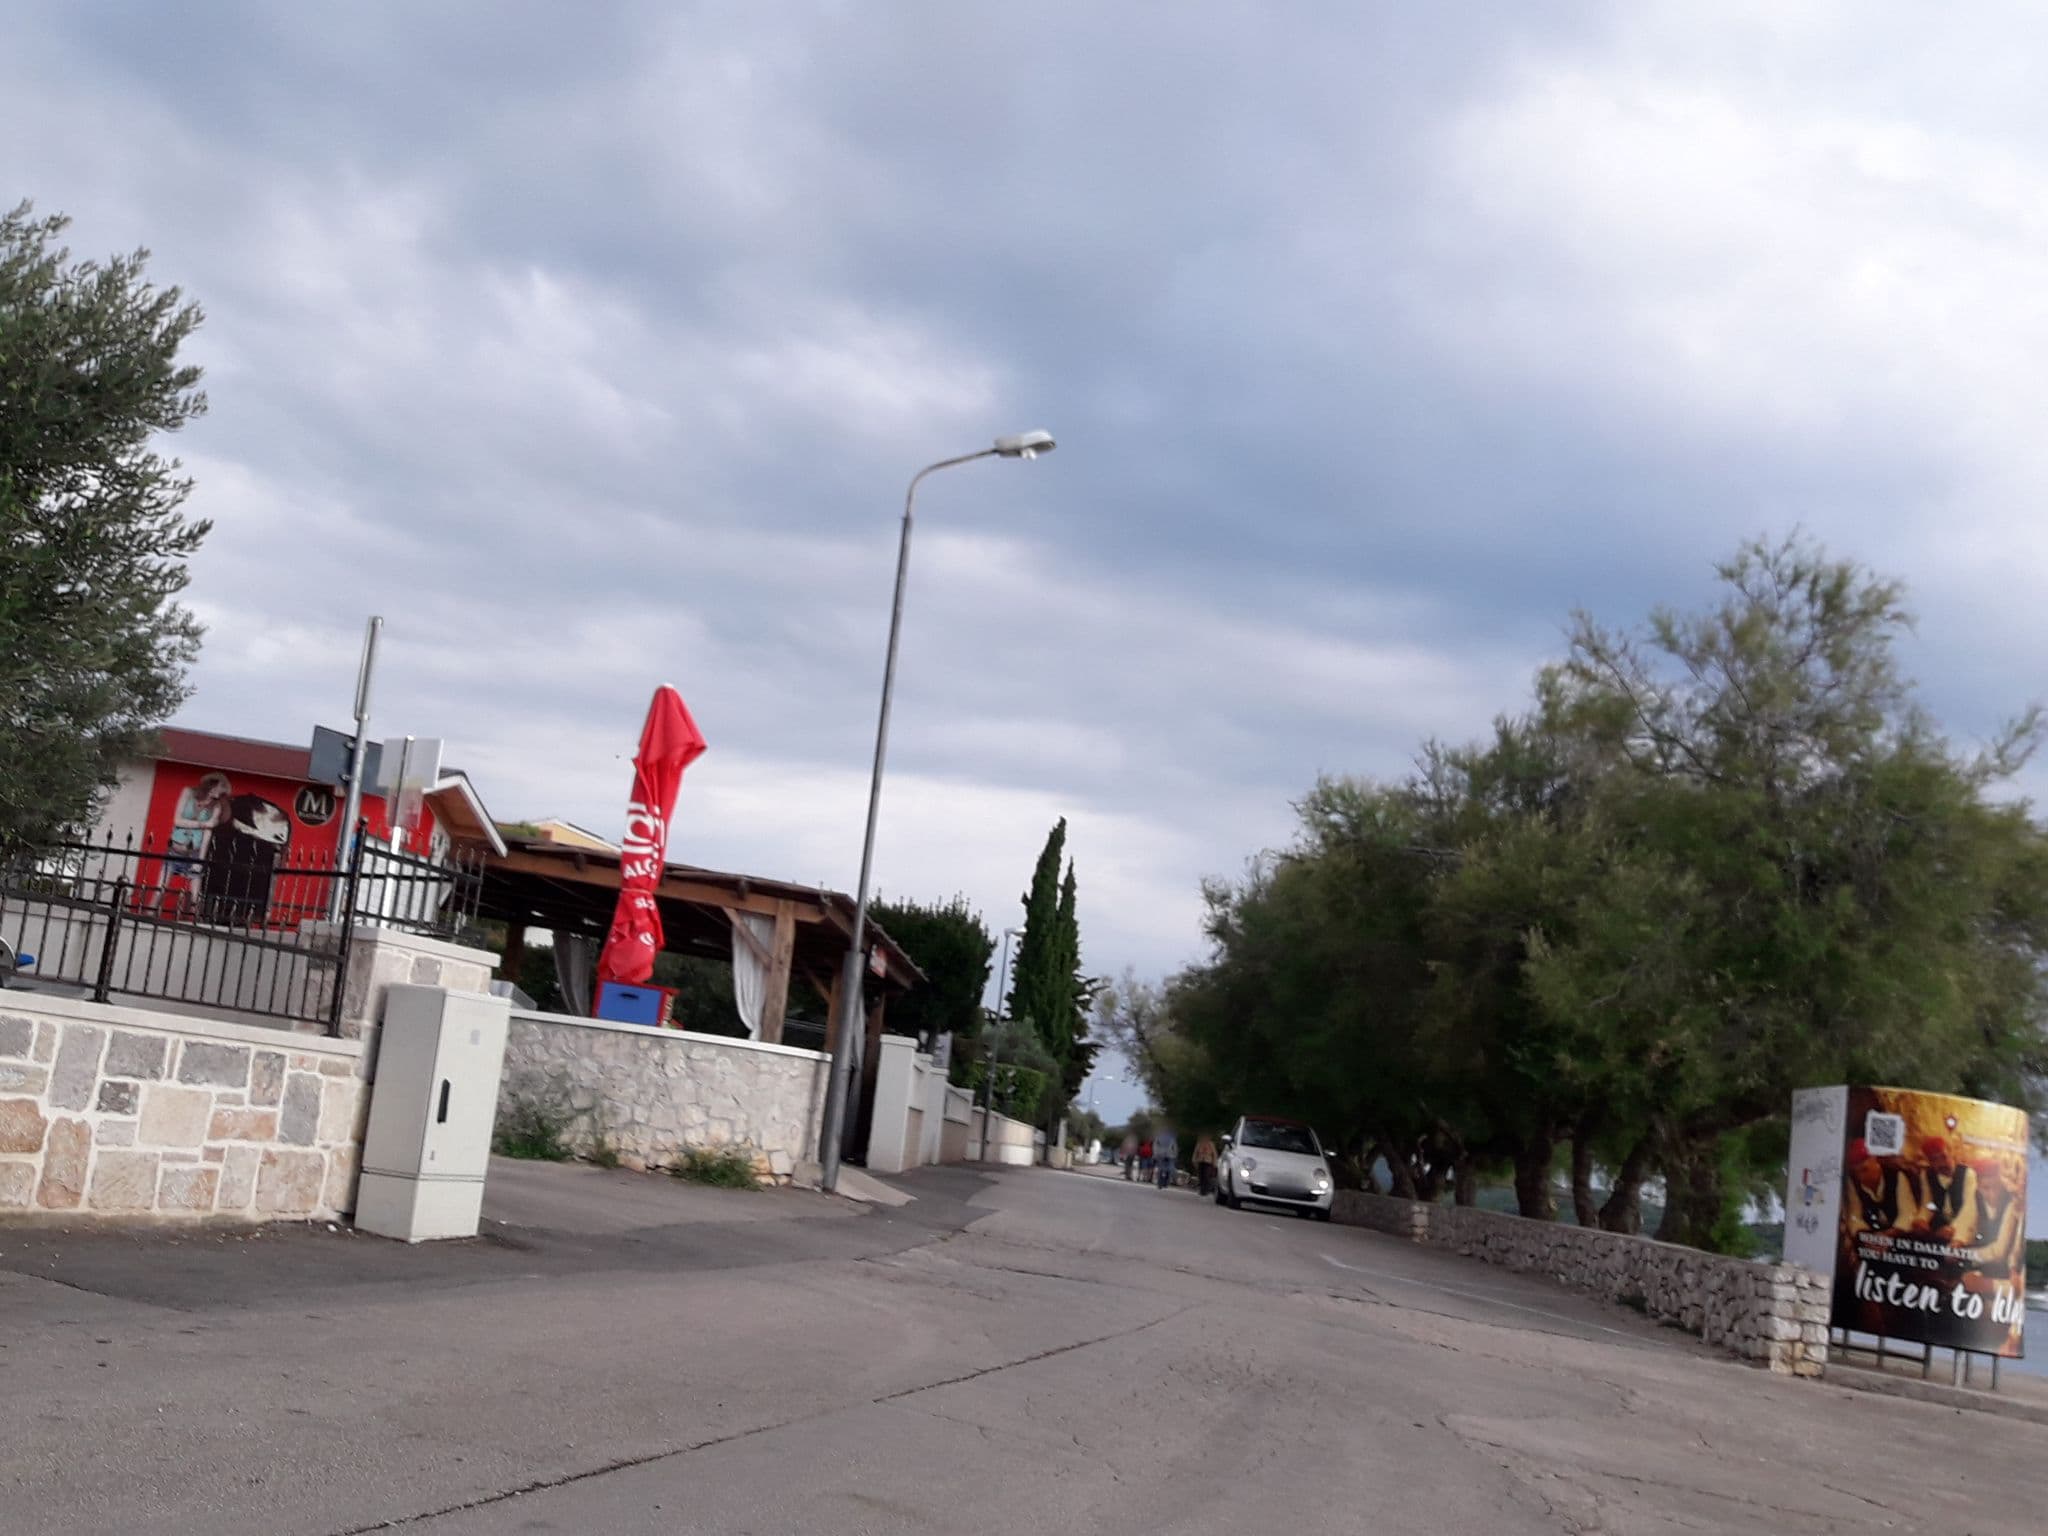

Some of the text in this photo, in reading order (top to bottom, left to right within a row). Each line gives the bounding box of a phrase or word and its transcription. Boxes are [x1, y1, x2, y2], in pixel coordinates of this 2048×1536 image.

[303, 790, 328, 814] M
[1858, 1232, 1894, 1247] WHEN
[1896, 1238, 1912, 1250] IN
[1858, 1247, 1940, 1271] YOU HAVE TO
[1855, 1260, 1941, 1314] listen
[1951, 1282, 1984, 1320] to
